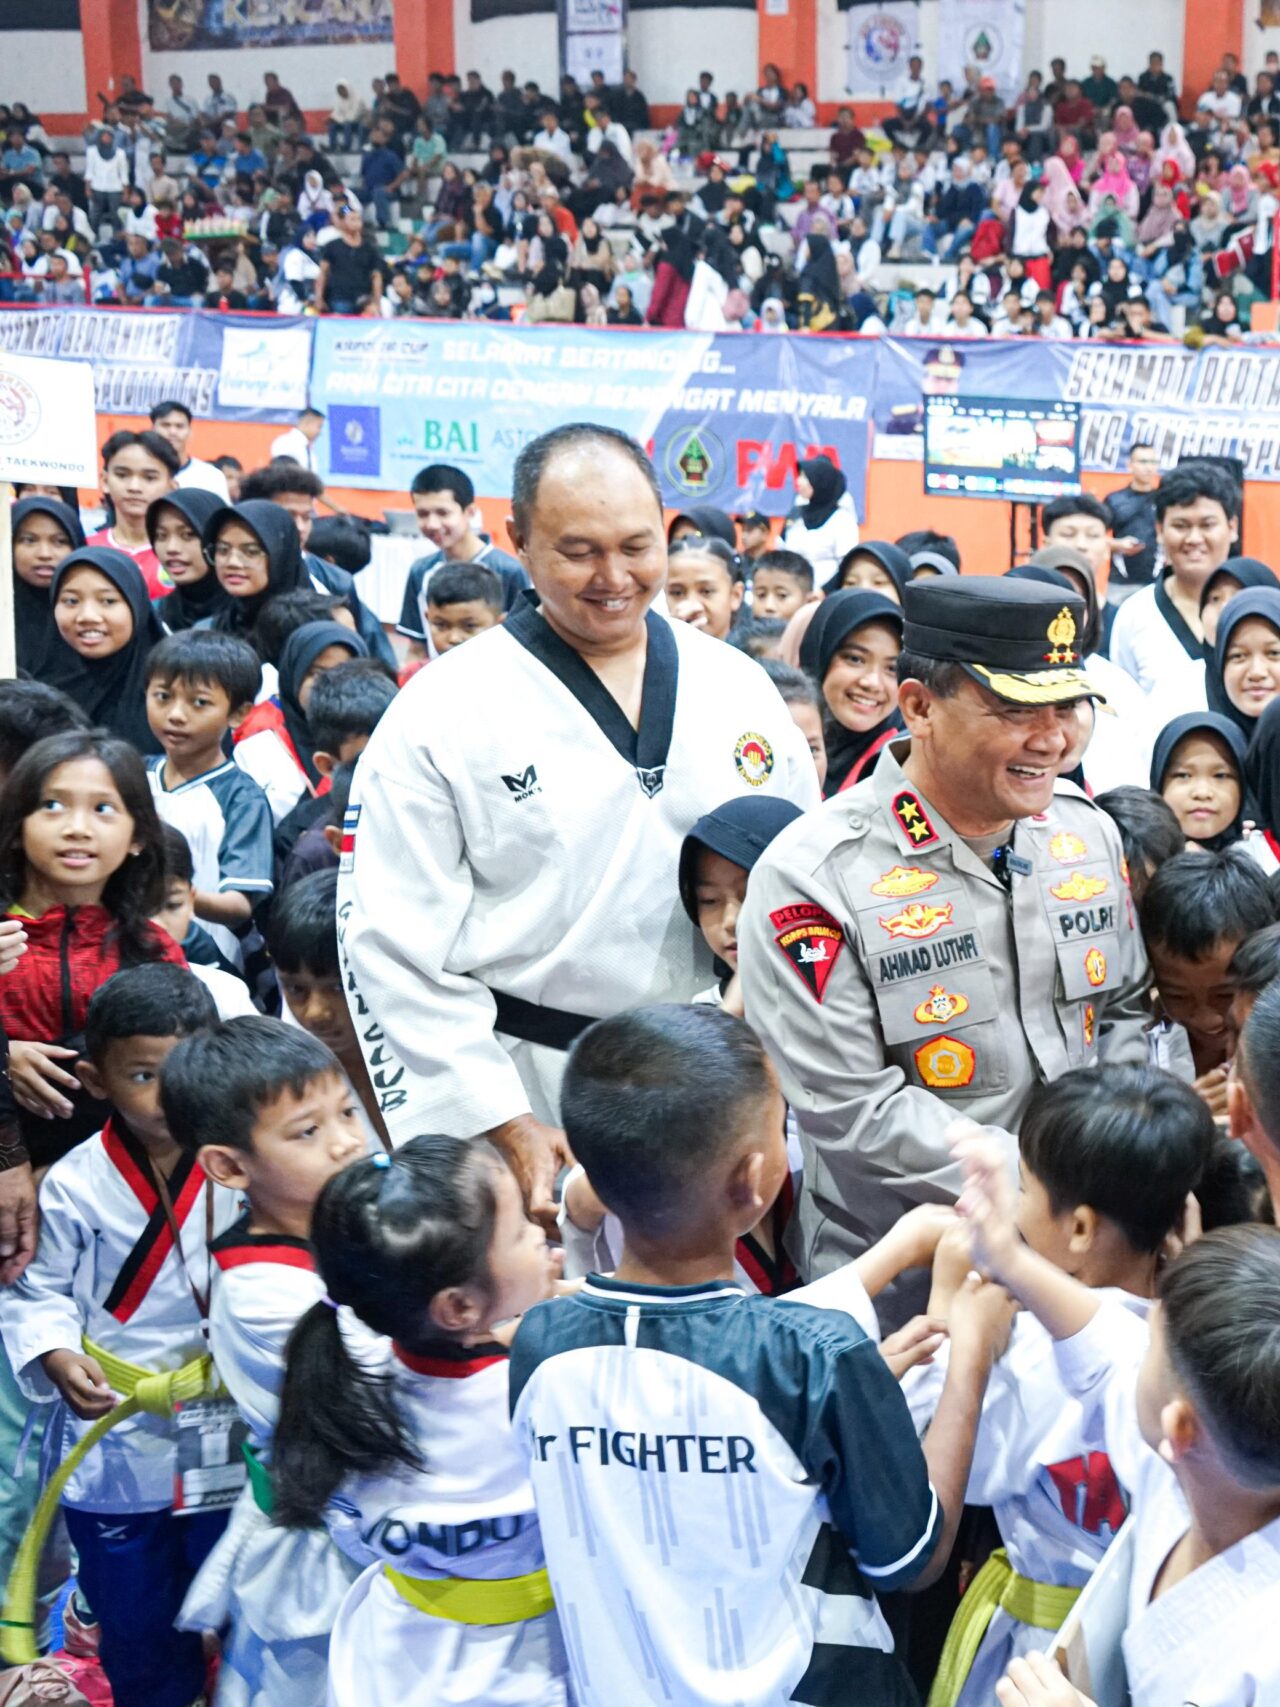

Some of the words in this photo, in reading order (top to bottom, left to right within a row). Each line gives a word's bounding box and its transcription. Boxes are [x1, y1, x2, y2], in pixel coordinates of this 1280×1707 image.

[737, 388, 868, 420] MENYALA
[423, 419, 479, 453] BAI
[6, 456, 86, 473] TAEKWONDO
[1058, 905, 1115, 938] POLRI
[879, 949, 932, 982] AHMAD
[932, 933, 979, 968] LUTHFI
[568, 1425, 759, 1474] FIGHTER
